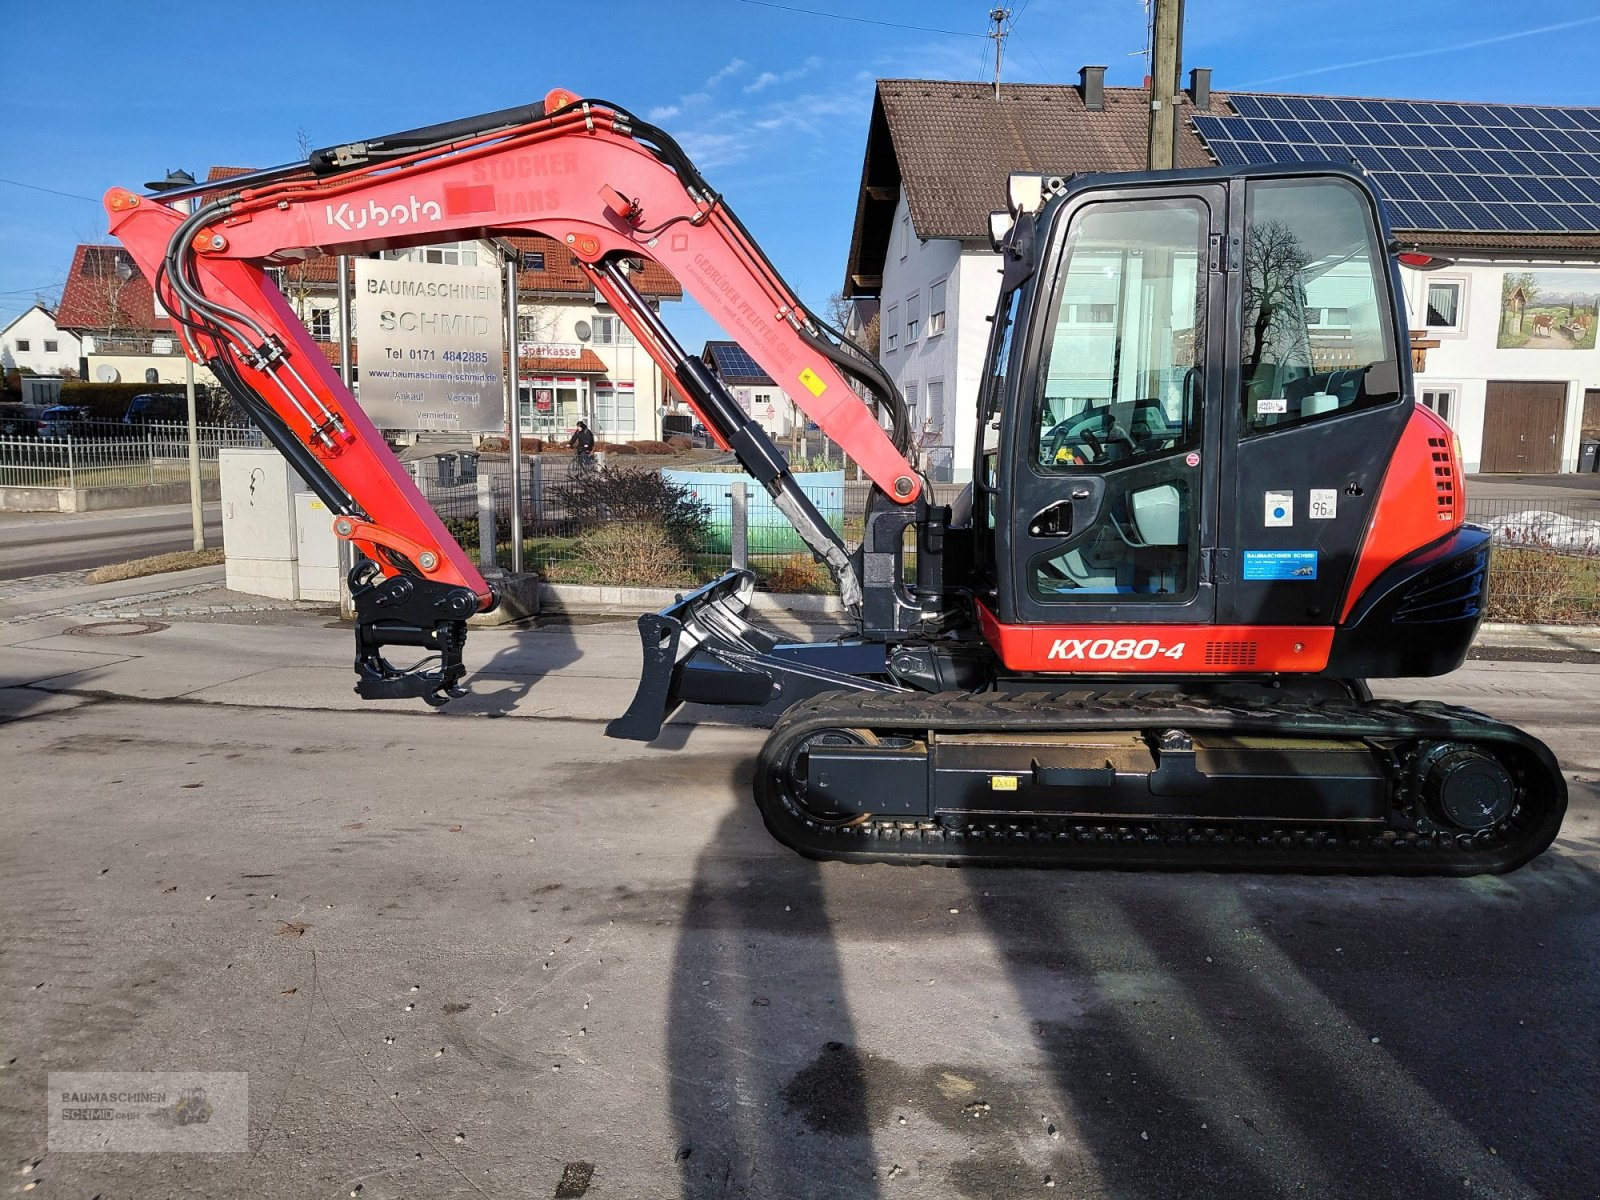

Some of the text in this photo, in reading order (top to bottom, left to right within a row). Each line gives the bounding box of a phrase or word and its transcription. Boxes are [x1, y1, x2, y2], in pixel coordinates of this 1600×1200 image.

[472, 151, 579, 183] STOCKER
[496, 188, 560, 215] HANS
[325, 195, 442, 231] Kubota
[367, 279, 497, 301] BAUMASCHINEN
[380, 310, 489, 337] SCHMID
[385, 348, 488, 363] Tel 0171 4842885
[521, 345, 576, 357] Sparkasse
[368, 370, 497, 382] www.baumaschinen-schmid.de
[394, 391, 480, 403] Ankauf Verkauf
[416, 410, 460, 421] Vermietung
[1312, 502, 1327, 516] 96
[1047, 639, 1186, 660] KX080-4
